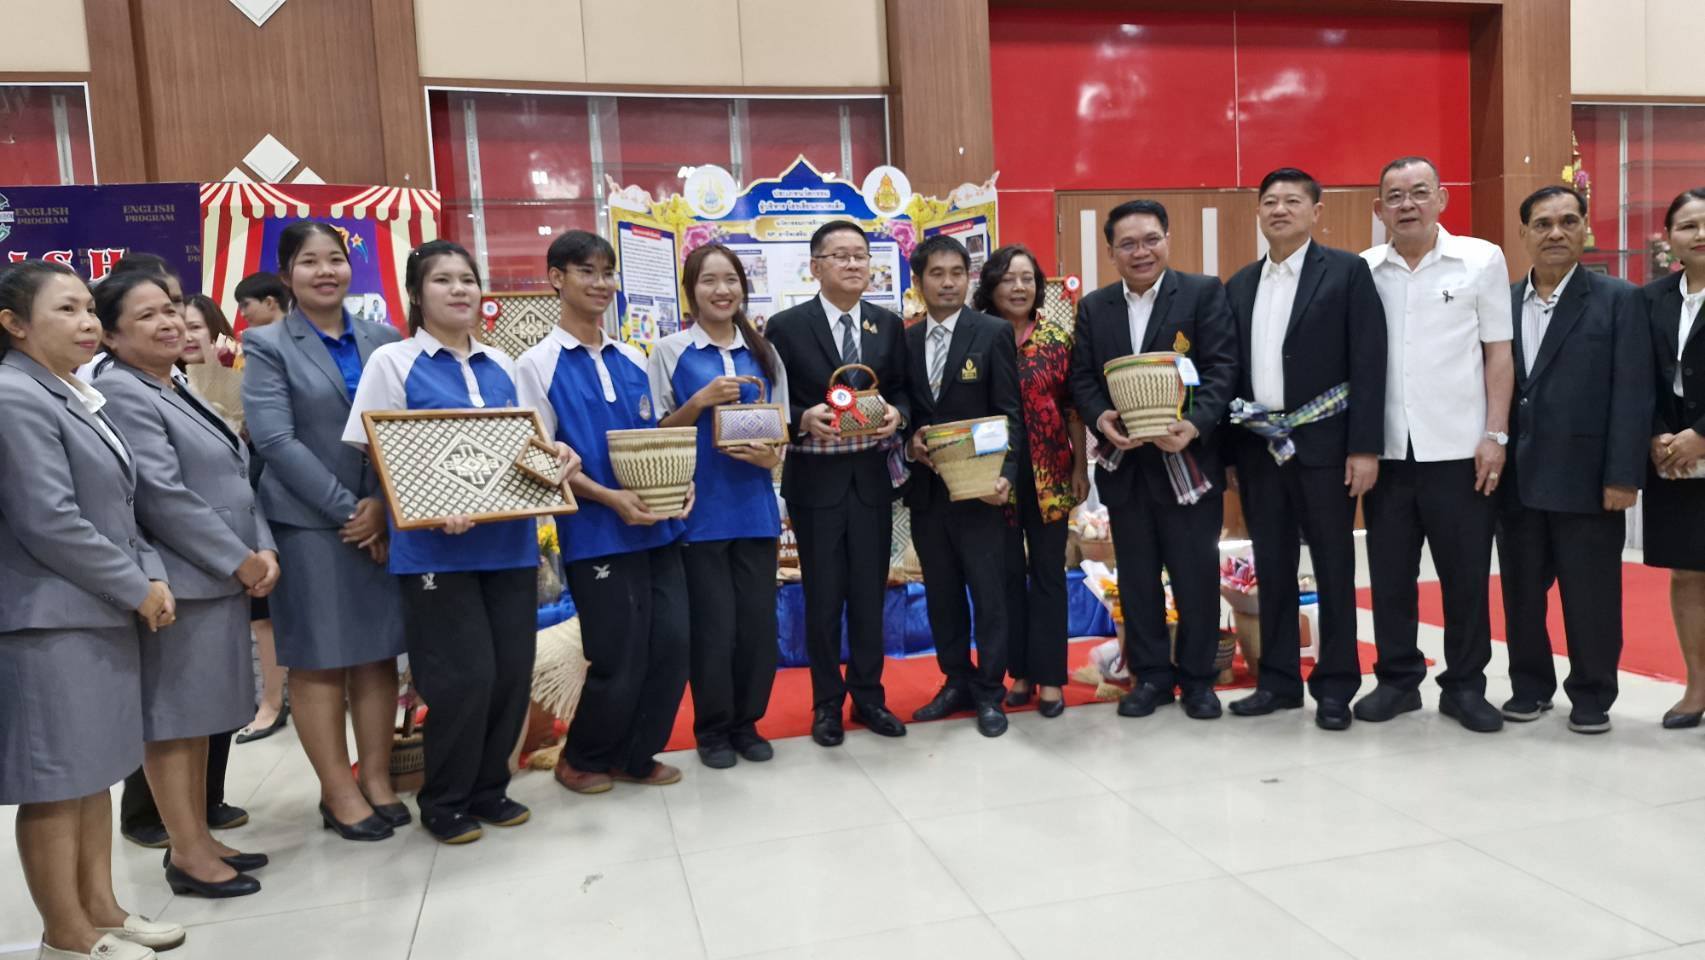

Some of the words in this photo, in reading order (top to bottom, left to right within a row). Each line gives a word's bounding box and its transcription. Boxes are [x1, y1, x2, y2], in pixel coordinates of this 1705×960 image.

[15, 207, 69, 216] ENGLISH
[123, 204, 175, 213] ENGLISH
[17, 217, 69, 225] PROGRAM
[125, 214, 175, 222] PROGRAM
